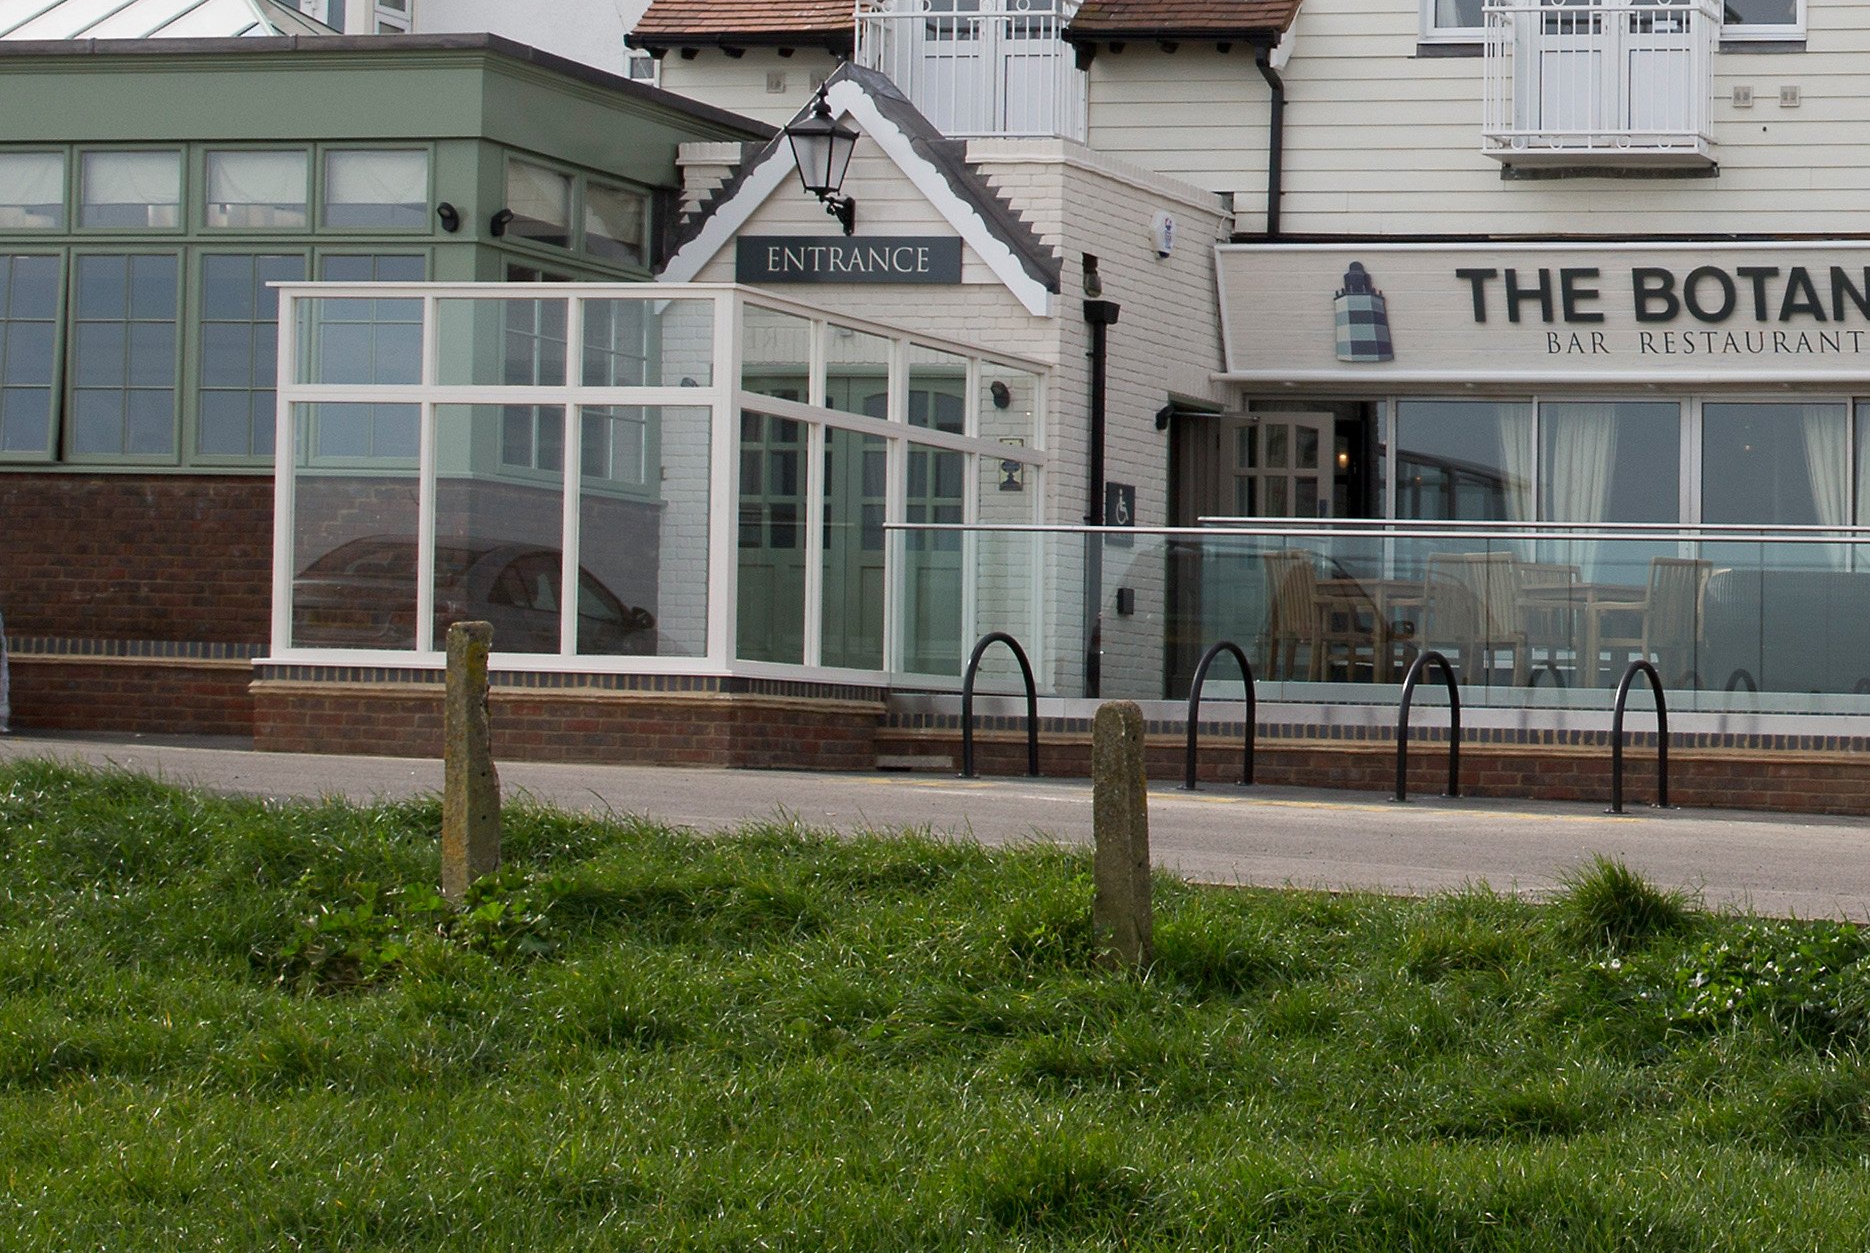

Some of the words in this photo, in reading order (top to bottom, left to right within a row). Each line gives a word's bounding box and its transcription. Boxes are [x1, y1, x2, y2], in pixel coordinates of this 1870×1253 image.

[767, 246, 930, 273] ENTRANCE
[1455, 266, 1606, 325] THE
[1546, 331, 1610, 355] BAR
[1639, 330, 1865, 355] RESTAURANT
